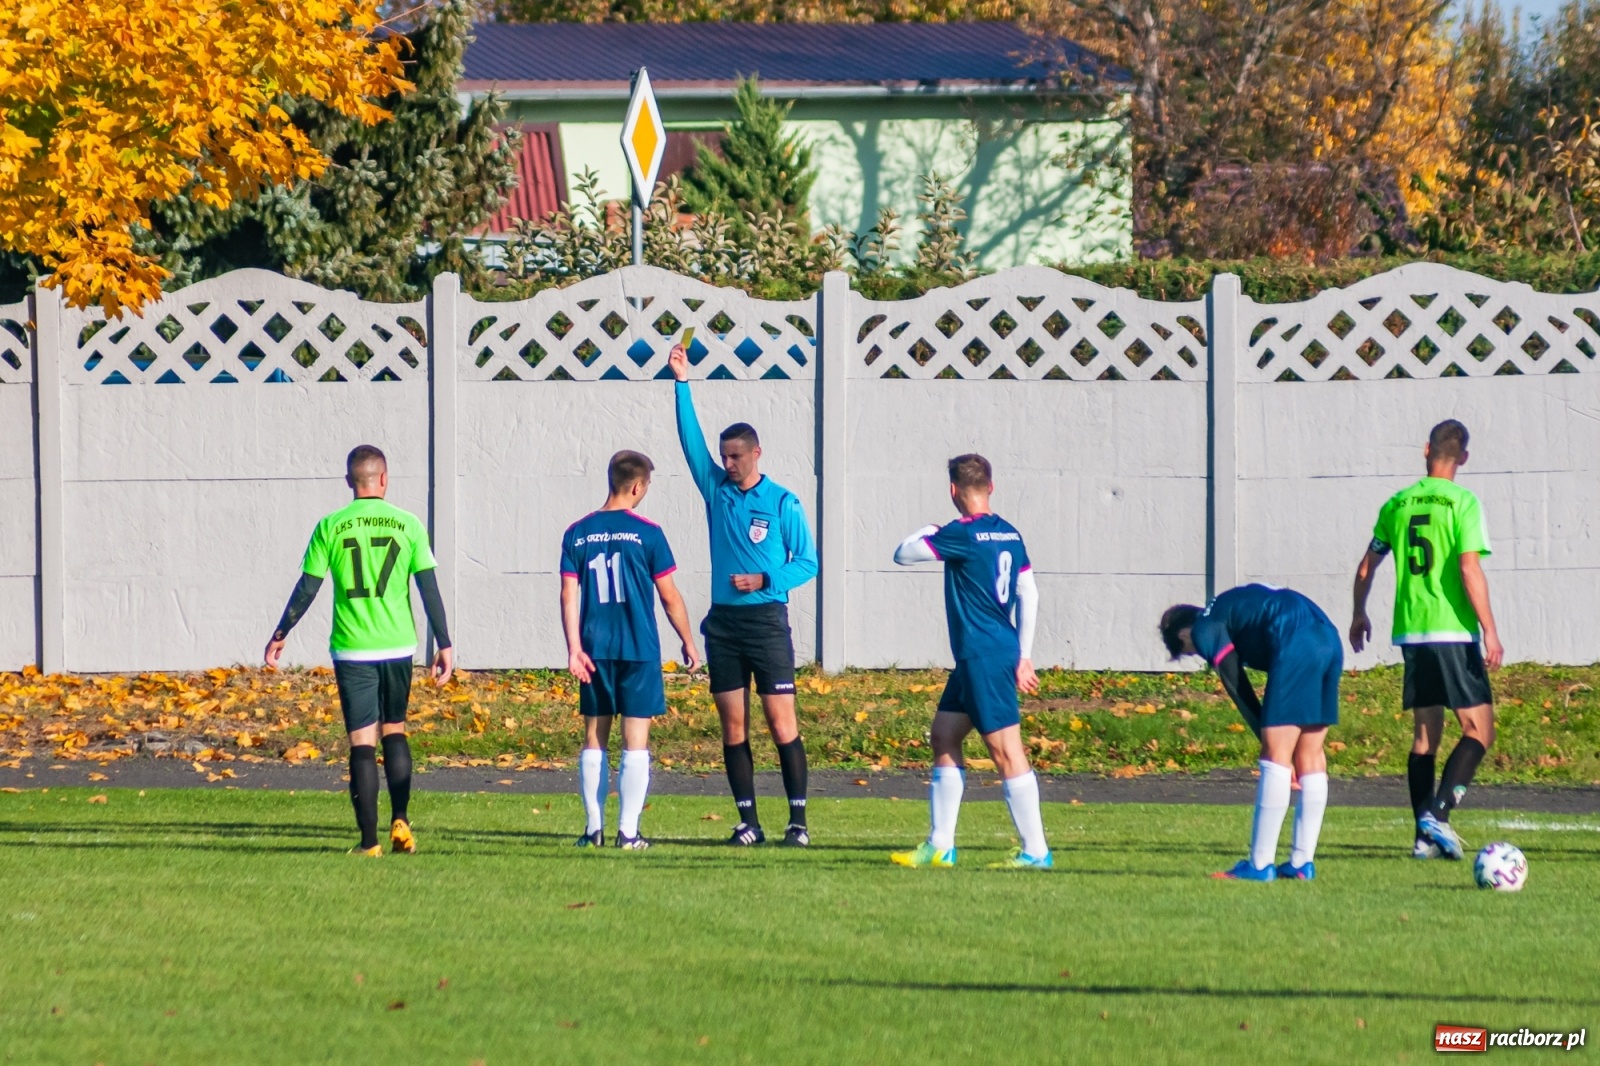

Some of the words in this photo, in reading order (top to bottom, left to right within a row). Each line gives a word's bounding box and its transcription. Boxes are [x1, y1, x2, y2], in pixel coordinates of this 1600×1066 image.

[335, 519, 353, 535] LKS
[356, 516, 405, 532] TWORKÓW
[1408, 513, 1434, 578] 5
[343, 536, 401, 598] 17
[588, 551, 626, 603] 11
[996, 550, 1012, 604] 8
